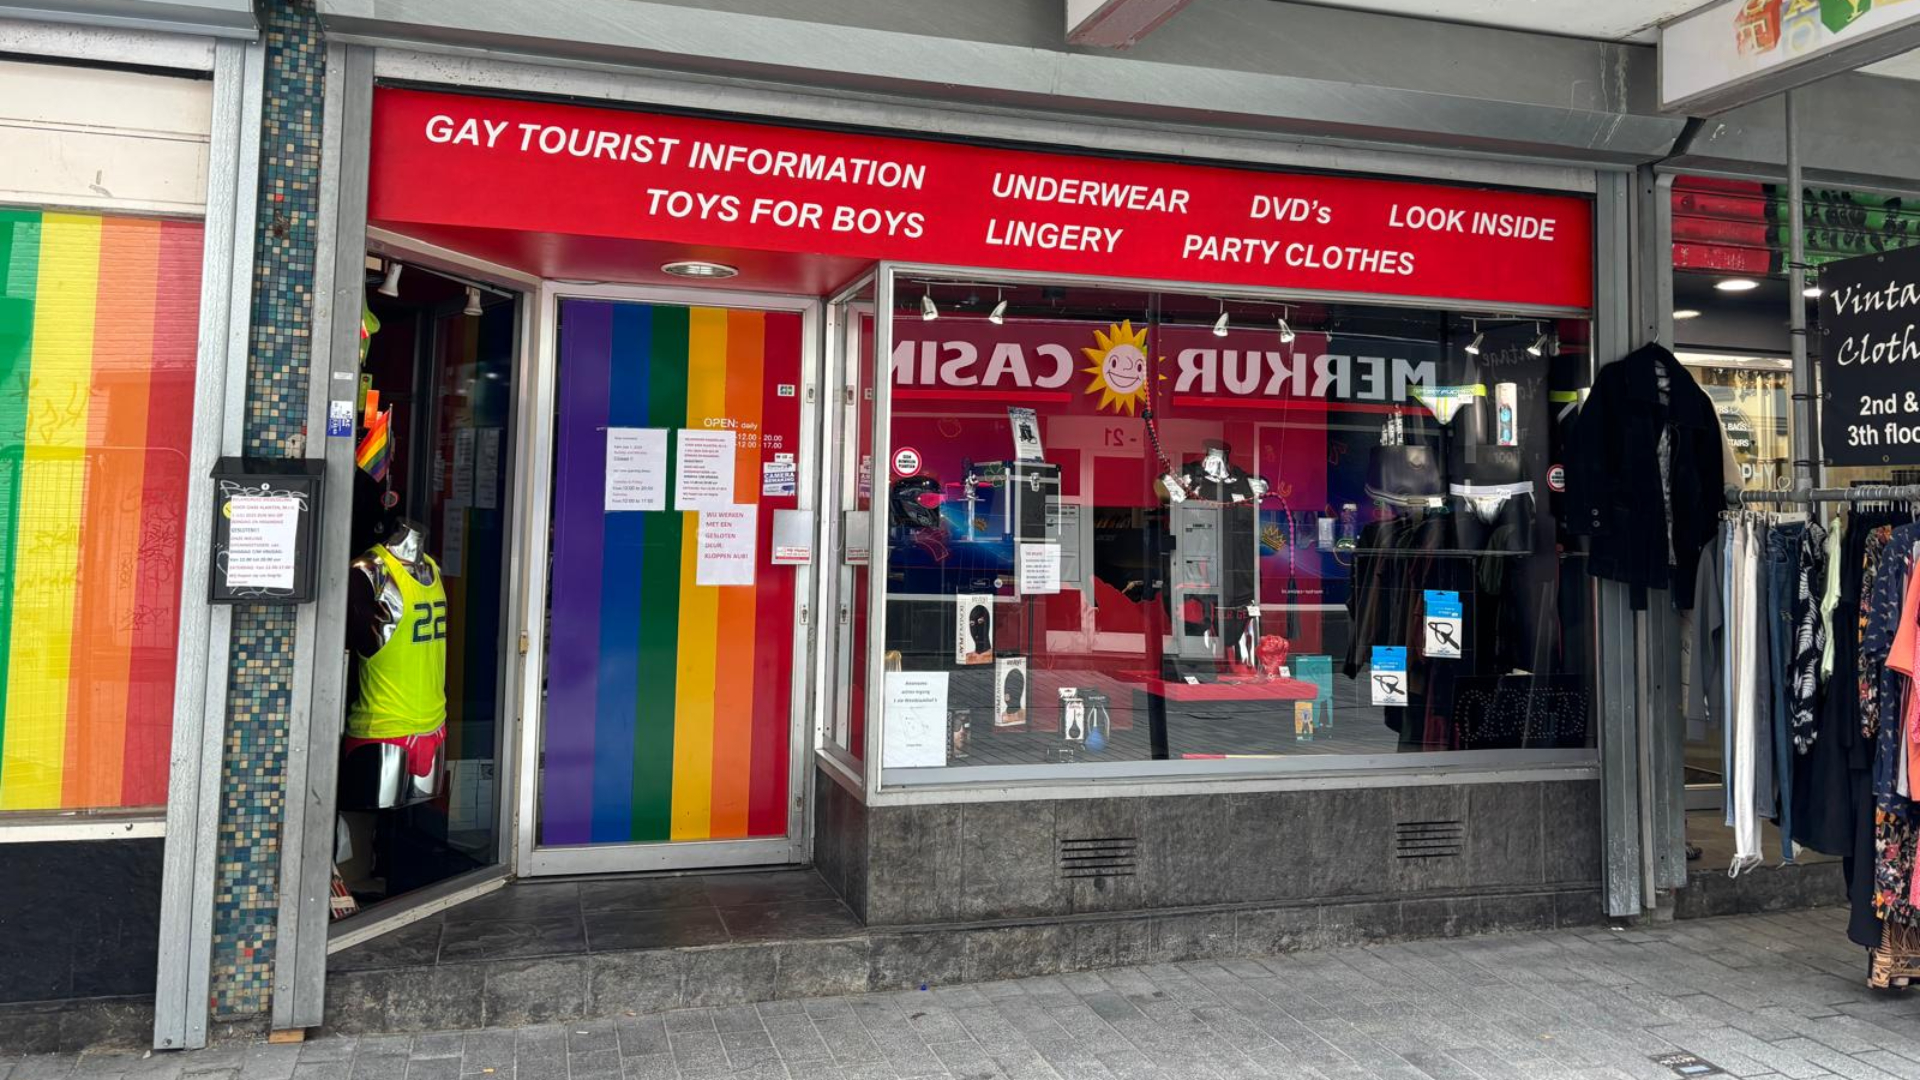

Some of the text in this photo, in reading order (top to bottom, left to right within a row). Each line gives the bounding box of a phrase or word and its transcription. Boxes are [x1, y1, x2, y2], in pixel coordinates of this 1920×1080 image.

[425, 114, 926, 190] GAY TOURIST INFORMATION
[992, 172, 1190, 214] UNDERWEAR
[1250, 195, 1332, 224] DVD's
[646, 188, 925, 238] TOYS FOR BOYS
[1388, 204, 1556, 241] LOOK INSIDE
[986, 218, 1123, 253] LINGERY
[1182, 234, 1415, 275] PARTY CLOTHES
[1830, 280, 1920, 315] Vinta
[1837, 324, 1920, 366] Cloth
[1860, 391, 1919, 416] 2nd &
[703, 417, 758, 430] OPEN: daily
[1727, 421, 1748, 431] BAGS
[1848, 424, 1879, 446] 3th
[412, 601, 447, 642] 22
